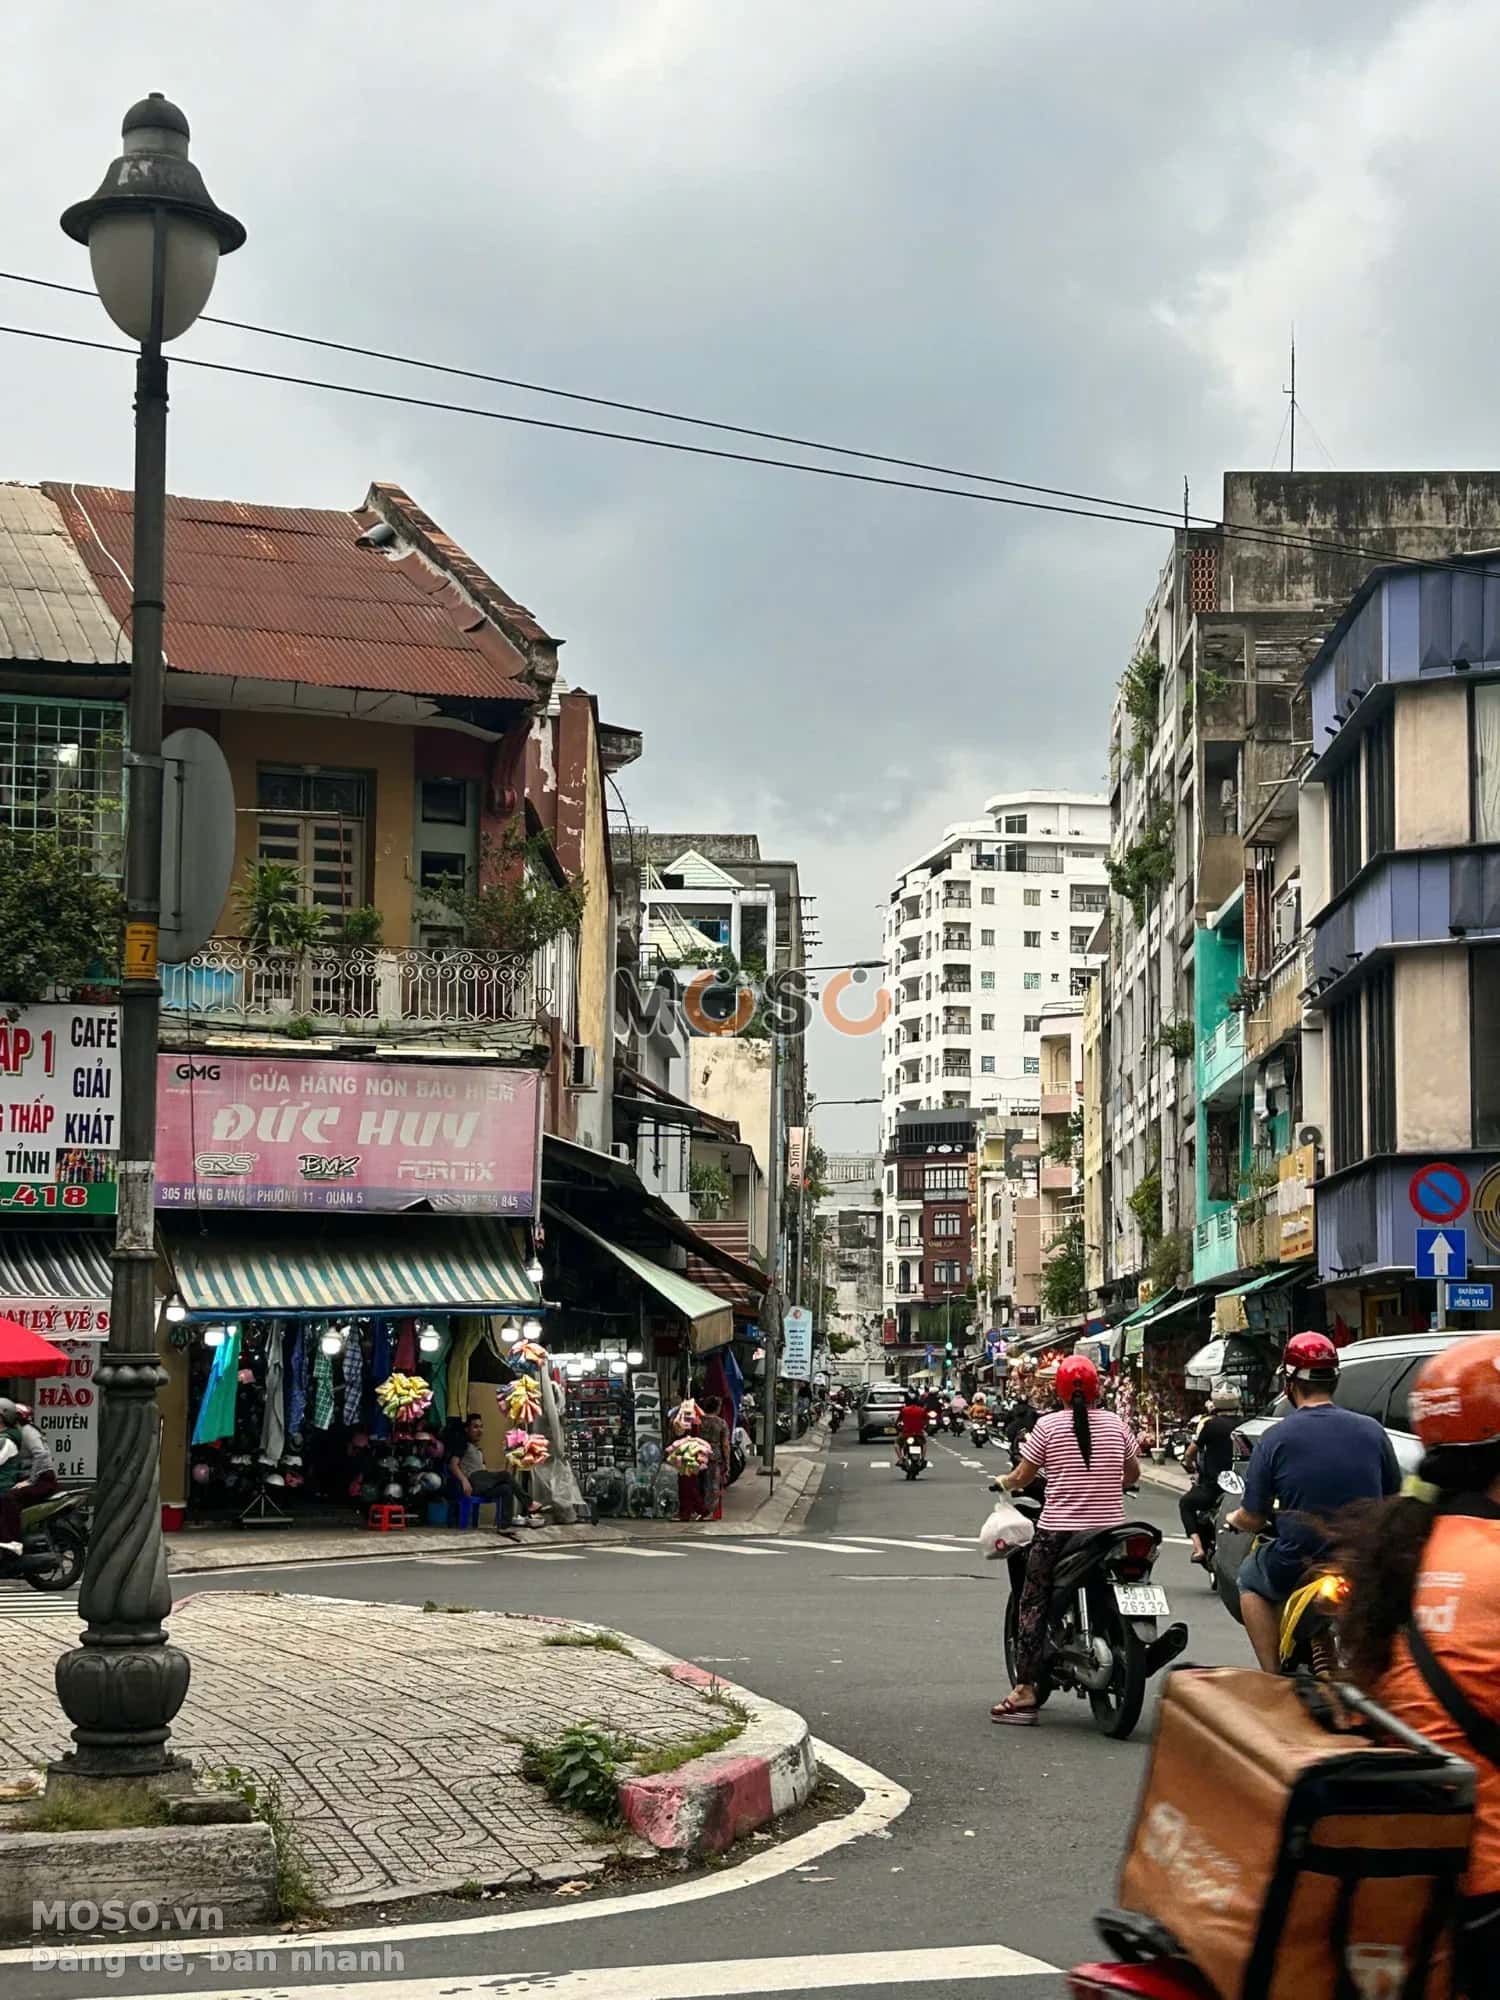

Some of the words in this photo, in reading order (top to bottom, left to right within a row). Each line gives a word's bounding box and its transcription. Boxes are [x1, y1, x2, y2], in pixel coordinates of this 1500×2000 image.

[71, 1012, 118, 1048] CAFÉ
[41, 1028, 55, 1074] 1
[73, 1057, 111, 1098] GIẢI
[176, 1063, 221, 1080] GMG
[250, 1068, 290, 1093] CỬA
[300, 1072, 357, 1096] HÀNG
[365, 1074, 408, 1097] NÓN
[9, 1094, 54, 1133] THẤP
[64, 1108, 115, 1144] KHÁT
[212, 1099, 341, 1144] ĐỨC
[357, 1109, 481, 1147] HUY
[5, 1143, 50, 1174] TỈNH
[162, 1187, 180, 1200] 305
[39, 1383, 94, 1407] HÀO
